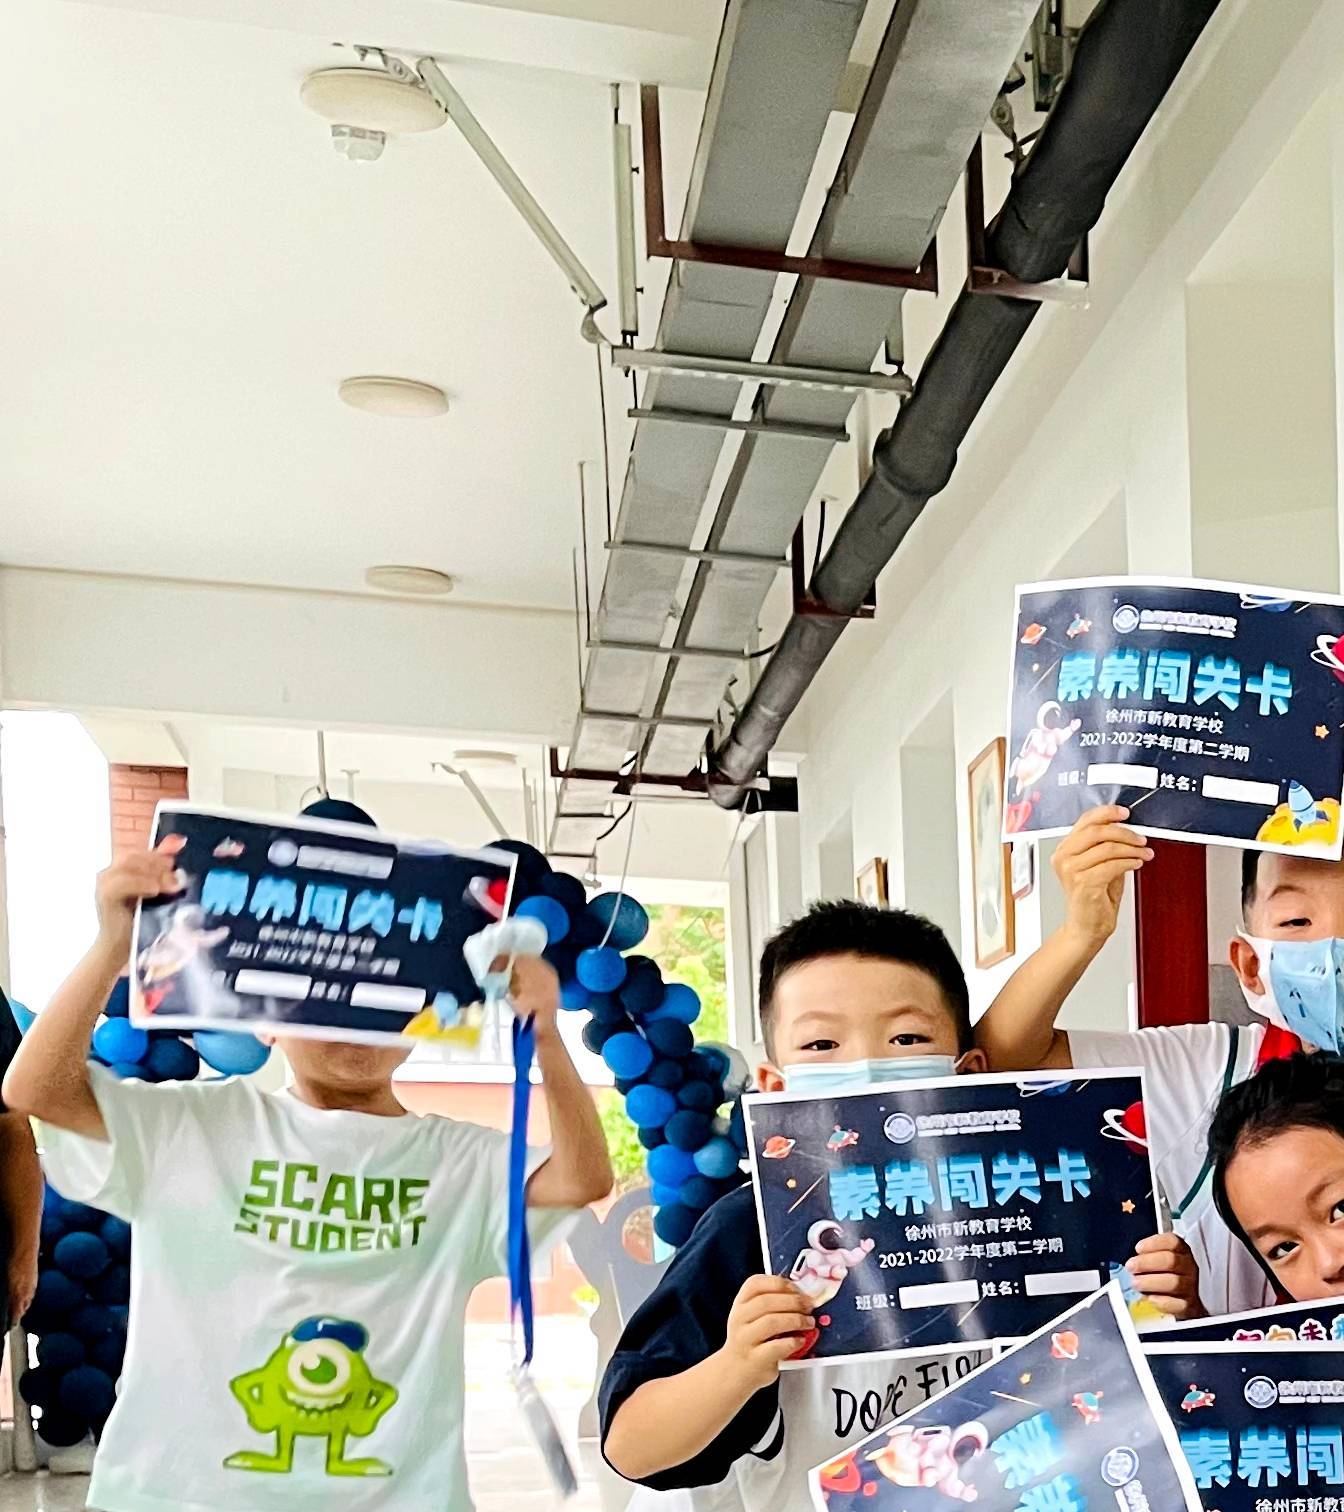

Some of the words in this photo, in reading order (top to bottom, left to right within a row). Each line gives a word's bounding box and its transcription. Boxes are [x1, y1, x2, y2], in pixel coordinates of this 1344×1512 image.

[1057, 648, 1293, 717] 素养闯关卡
[1106, 709, 1223, 734] 徐州市新教育学校
[1080, 732, 1250, 762] 2021-2022学年度第二学期
[828, 1148, 1091, 1222] 素养闯关卡
[234, 1207, 427, 1252] STUDENT
[904, 1215, 1033, 1242] 徐州市新教育学校
[878, 1237, 1065, 1269] 2021-2022学年度第二学期
